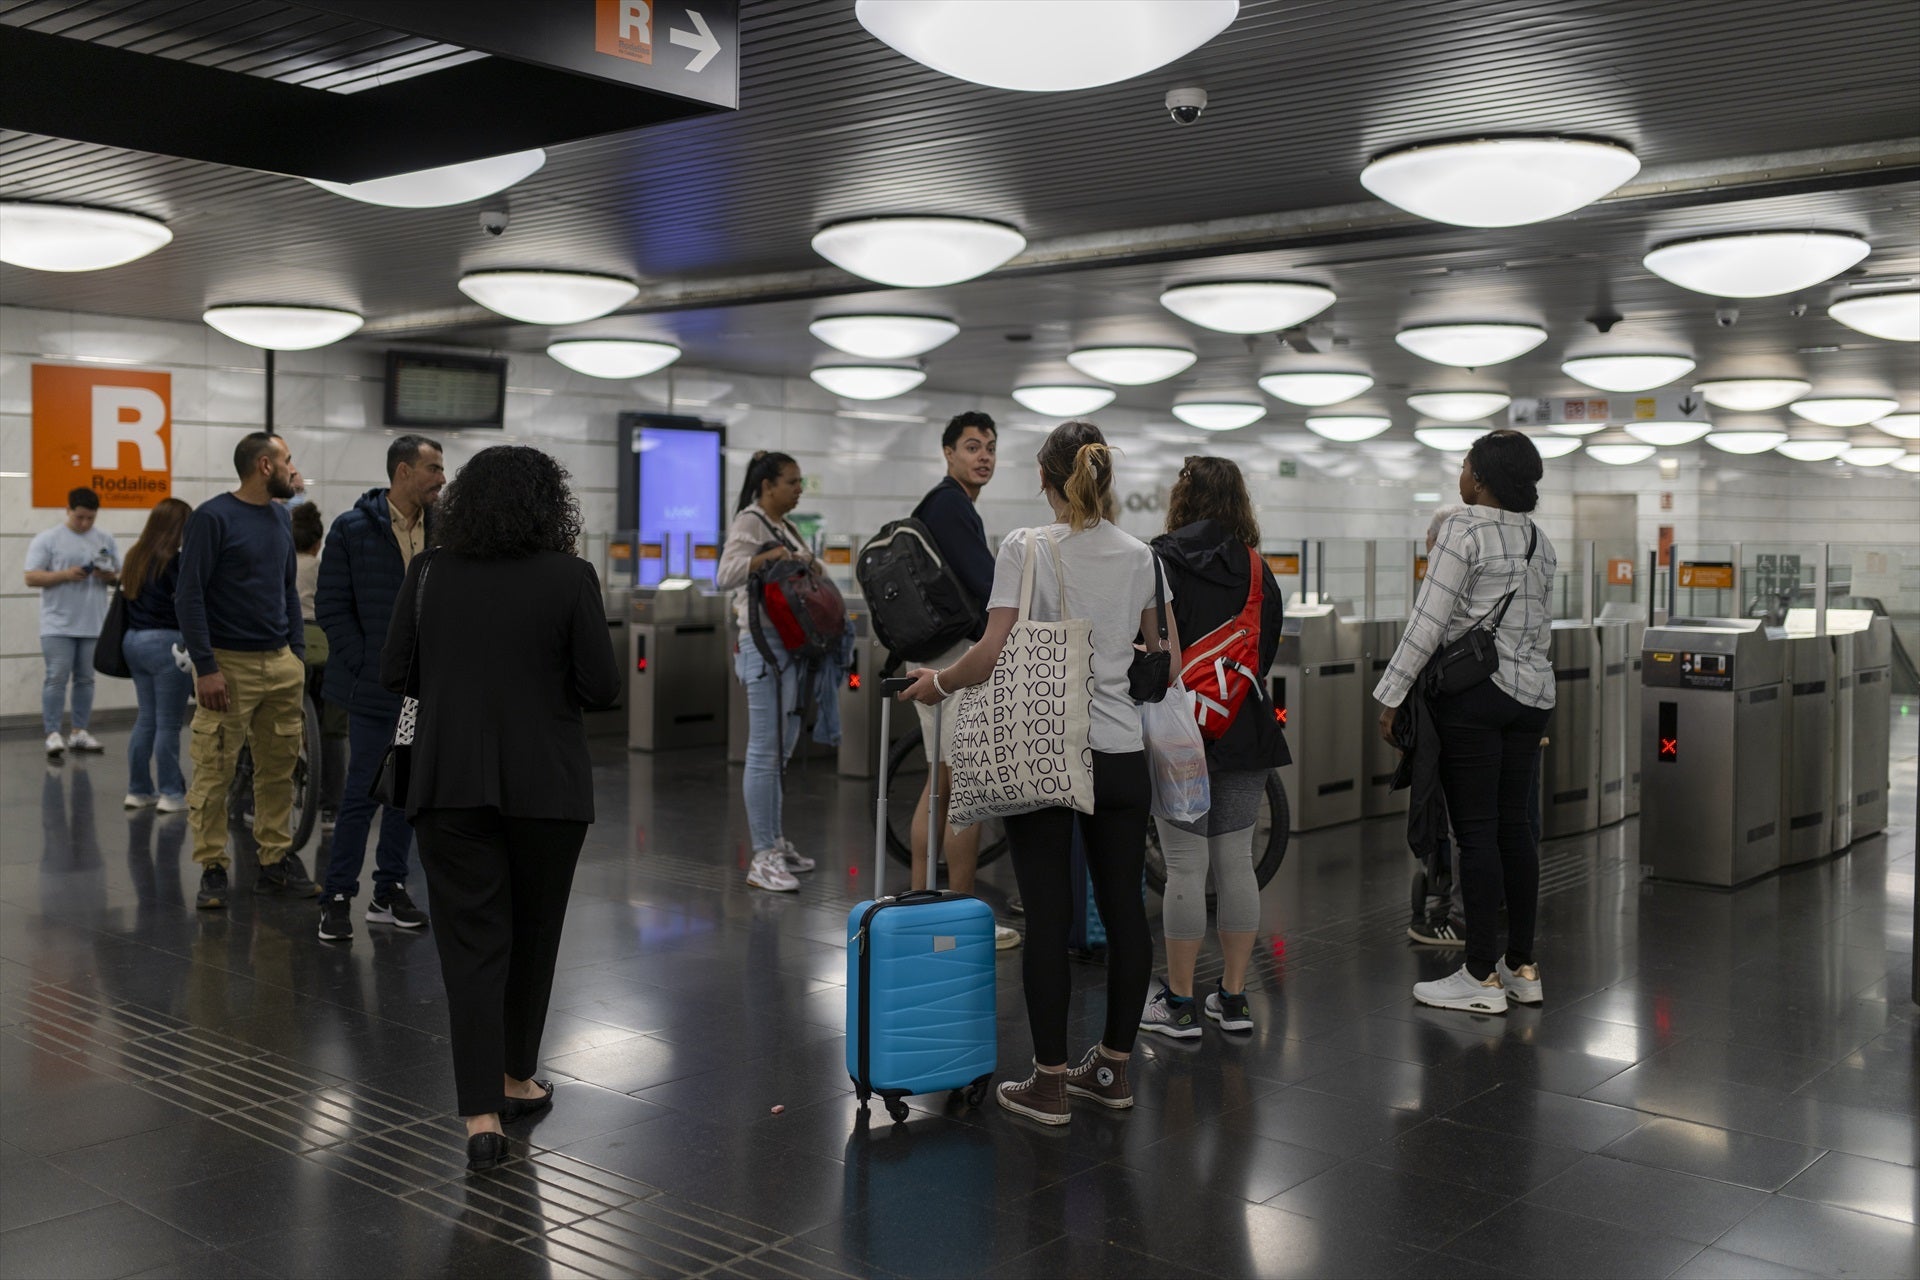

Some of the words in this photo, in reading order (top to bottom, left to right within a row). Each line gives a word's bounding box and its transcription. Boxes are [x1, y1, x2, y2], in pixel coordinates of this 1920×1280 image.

[619, 0, 651, 44] R
[91, 384, 168, 471] R
[92, 475, 168, 493] Rodalies
[1616, 562, 1633, 580] R
[1004, 627, 1021, 646] Y
[1026, 627, 1067, 645] YOU
[995, 646, 1020, 667] BY
[1024, 645, 1067, 663] YOU
[994, 664, 1019, 686] BY
[1023, 663, 1066, 680] YOU
[993, 683, 1018, 705] BY
[1023, 681, 1066, 698] YOU
[993, 702, 1018, 724] BY
[1022, 699, 1065, 717] YOU
[993, 721, 1017, 744] BY
[1022, 718, 1065, 736] YOU
[994, 741, 1018, 764] BY
[1022, 738, 1065, 757] YOU
[952, 770, 997, 790] RSHKA
[997, 761, 1020, 783] BY
[1024, 757, 1067, 776] YOU
[950, 788, 1005, 810] ERSHKA
[1002, 781, 1025, 801] BY
[1028, 774, 1072, 795] YOU
